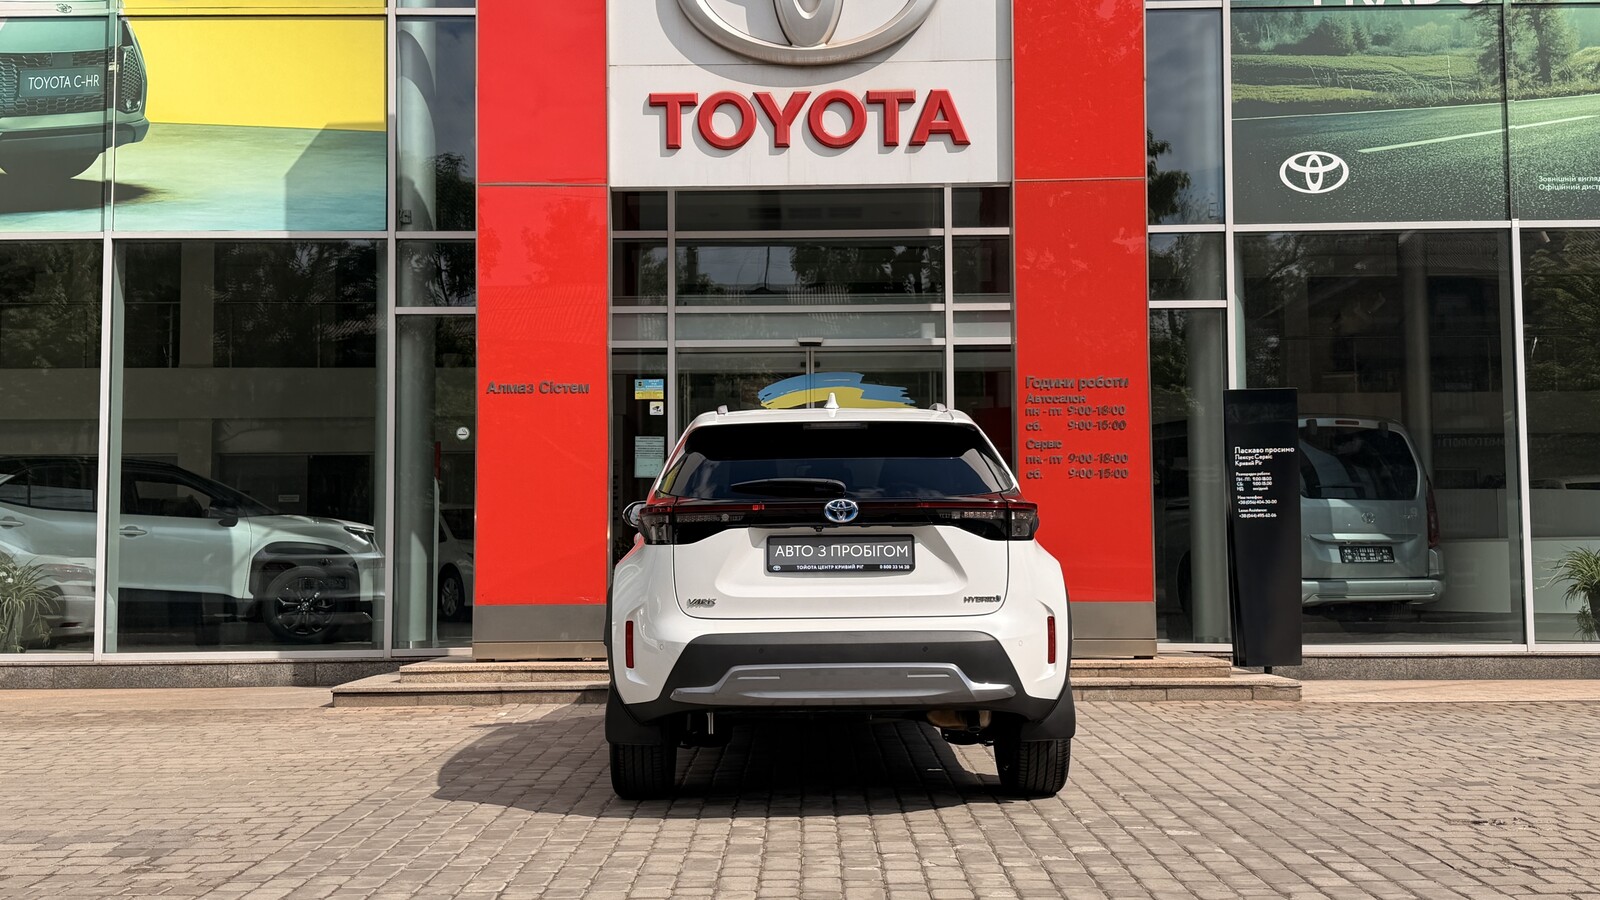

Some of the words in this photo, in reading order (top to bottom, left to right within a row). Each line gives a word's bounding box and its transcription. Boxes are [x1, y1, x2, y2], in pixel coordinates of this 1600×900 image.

[28, 75, 71, 90] TOYOTA
[73, 74, 100, 88] C-HR
[648, 88, 971, 150] TOYOTA
[1538, 174, 1576, 183] Зовнішній
[1538, 183, 1580, 191] Офіційний
[486, 380, 535, 394] Алмаз
[538, 380, 590, 394] Сістем
[1025, 375, 1075, 391] Години
[1078, 376, 1129, 391] роботи
[1025, 393, 1086, 404] Автосалон
[1066, 405, 1127, 416] 9:00-18:00
[1067, 420, 1127, 431] 9:00-15:00
[1026, 438, 1063, 452] Сервіс
[1068, 453, 1129, 464] 9:00-18:00
[1068, 468, 1129, 479] 9:00-15:00
[775, 545, 814, 557] АВТО
[817, 545, 827, 557] З
[830, 545, 908, 557] ПРОБІГОМ
